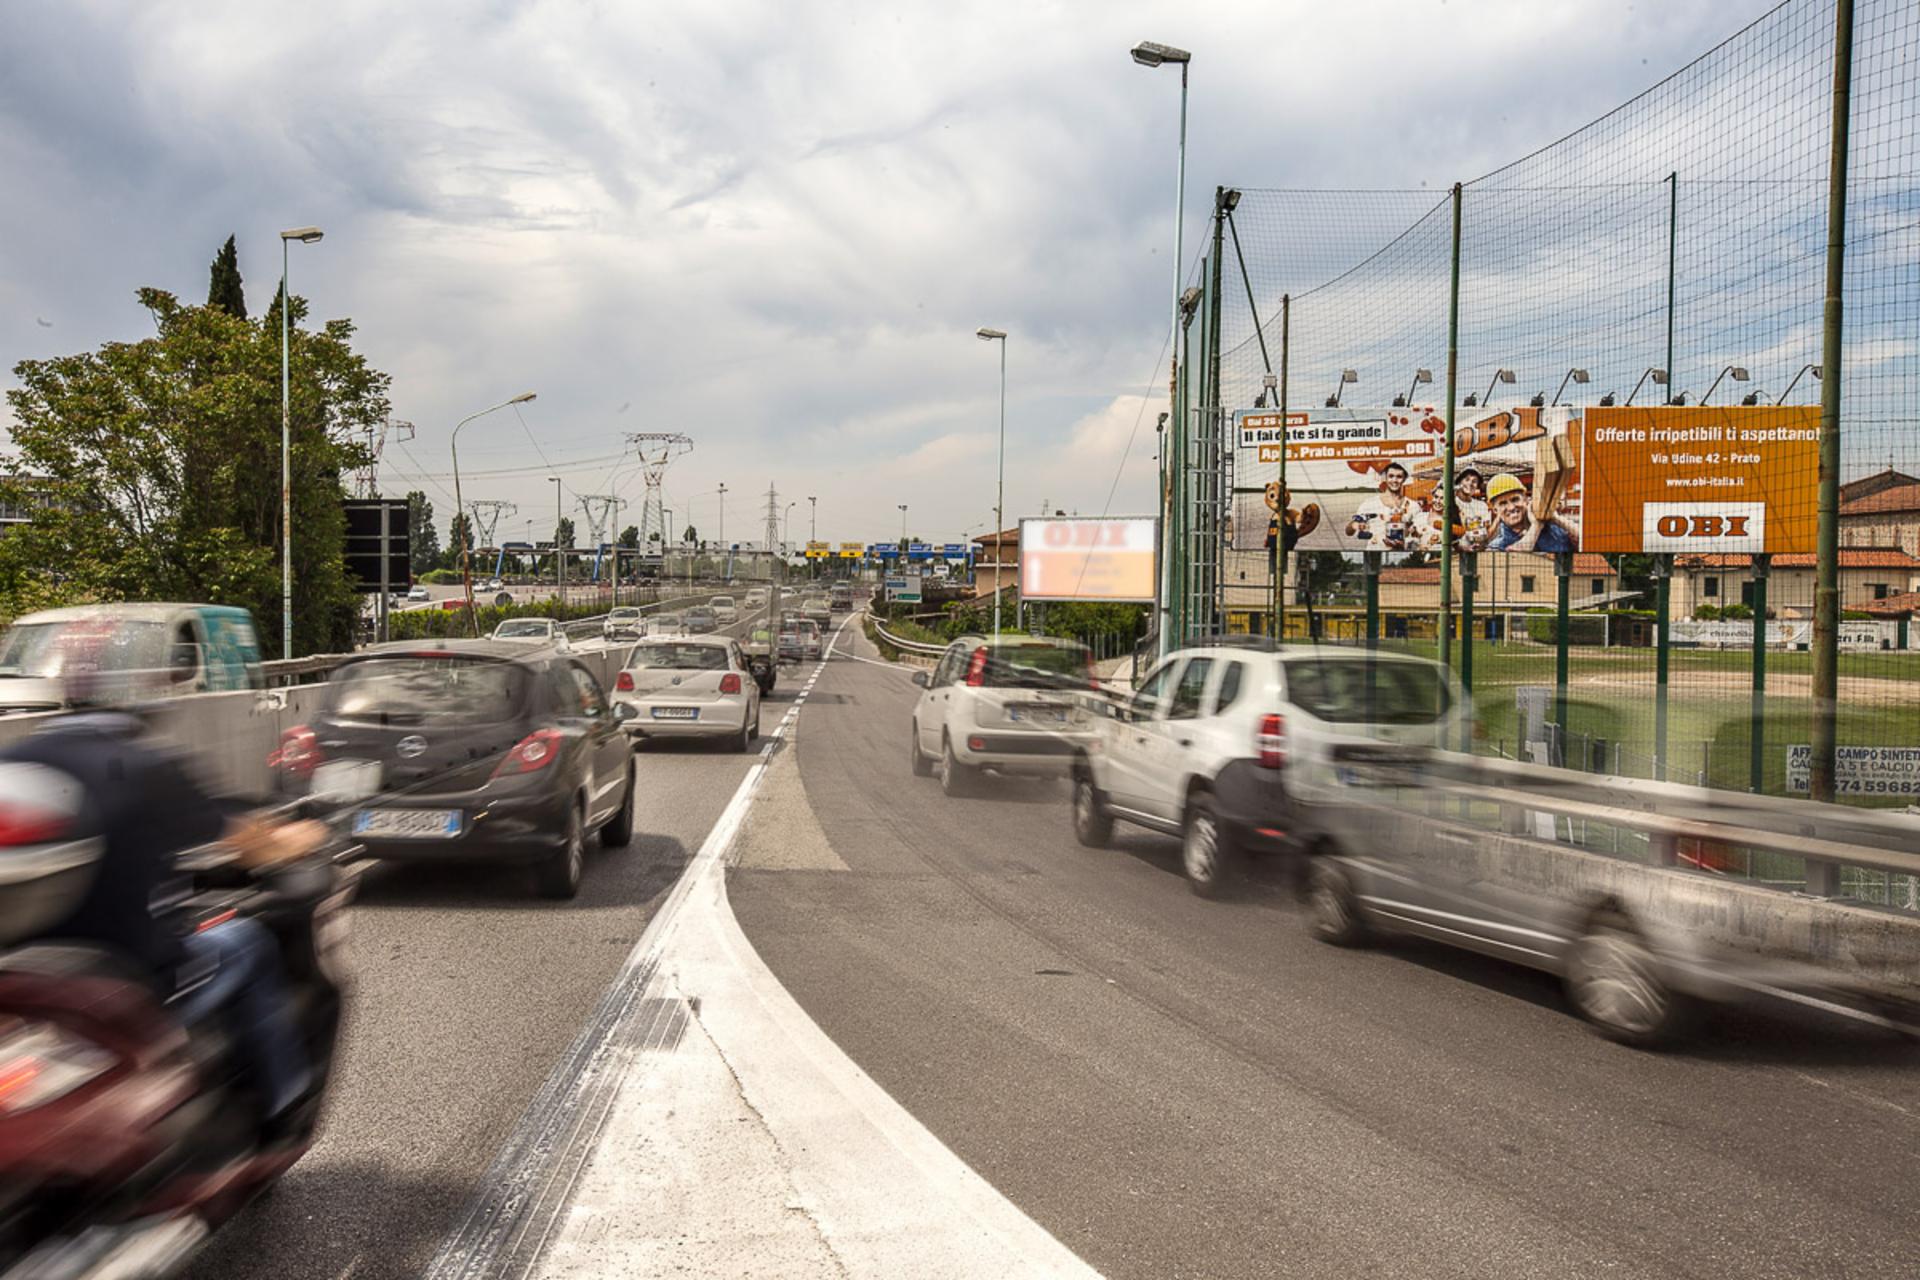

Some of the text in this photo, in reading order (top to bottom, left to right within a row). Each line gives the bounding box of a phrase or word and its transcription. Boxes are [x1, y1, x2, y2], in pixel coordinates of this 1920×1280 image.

[1244, 431, 1253, 442] Il
[1257, 429, 1273, 441] fai
[1293, 429, 1305, 440] te
[1308, 428, 1319, 439] si
[1322, 427, 1334, 439] fa
[1337, 426, 1382, 440] grande
[1595, 427, 1821, 444] Offerte irripetibili ti aspettano!
[1261, 447, 1292, 461] Ape
[1300, 446, 1335, 459] Prato
[1343, 446, 1379, 456] nuovo
[1651, 453, 1669, 464] Via
[1671, 453, 1703, 464] Udine
[1705, 453, 1720, 464] 42
[1730, 453, 1761, 464] Prato
[1665, 476, 1745, 487] www.obi-italia.it
[1657, 515, 1750, 537] OBI
[1838, 748, 1877, 760] CAMPO
[1848, 762, 1857, 771] 5
[1860, 762, 1868, 771] E
[1871, 762, 1914, 772] CALCIO
